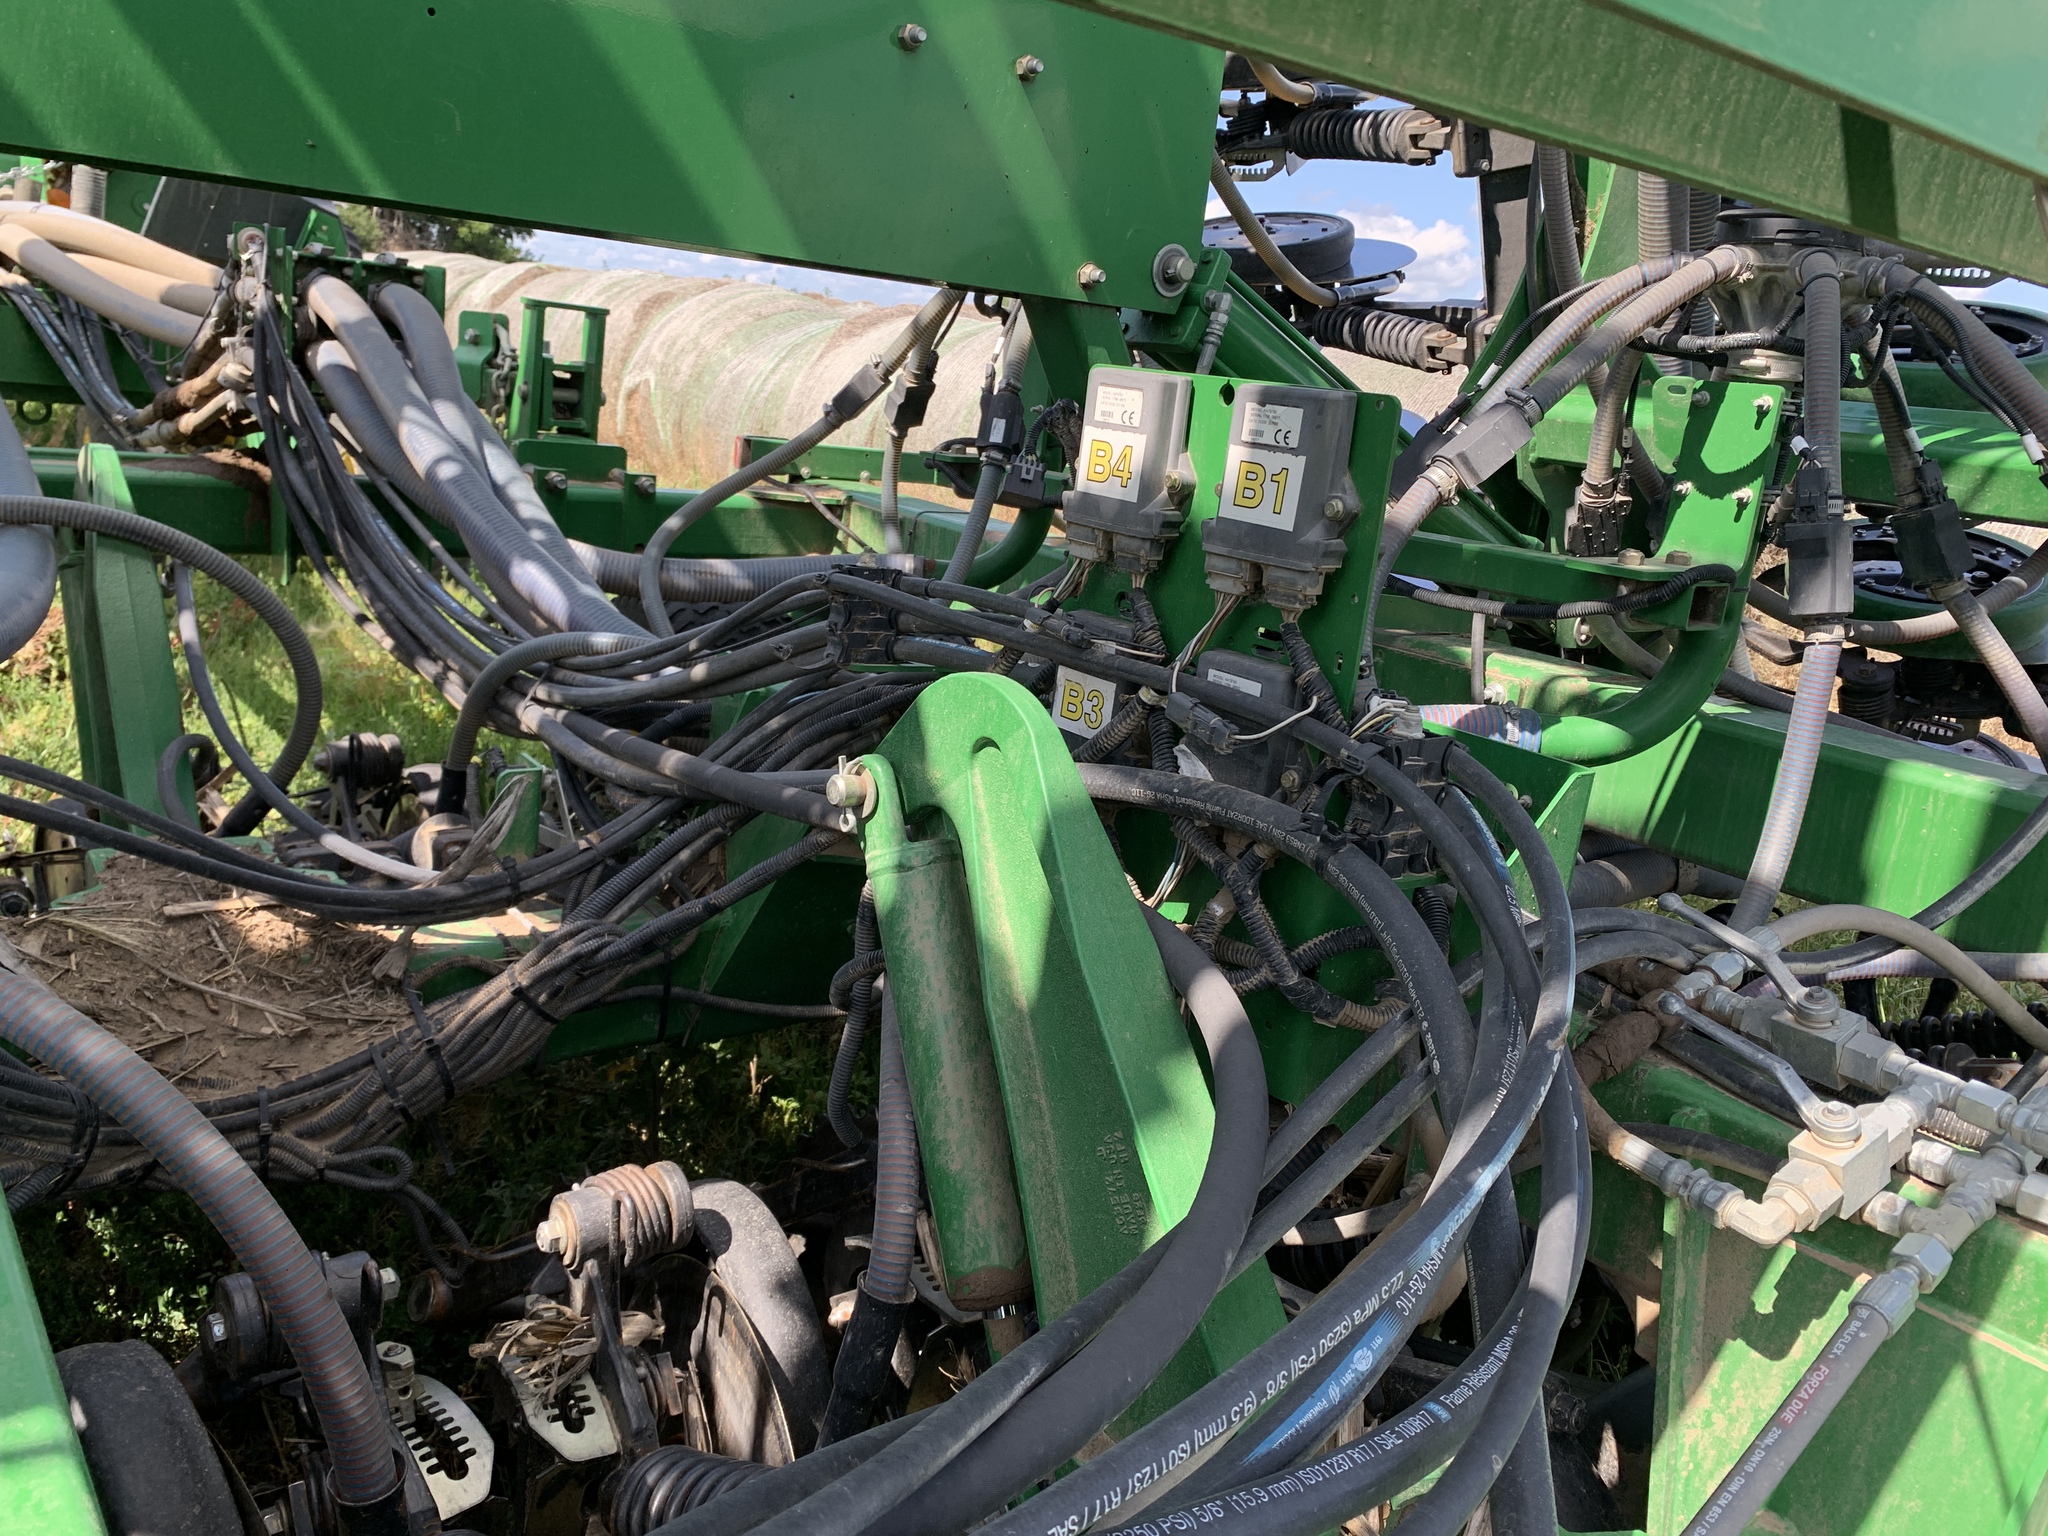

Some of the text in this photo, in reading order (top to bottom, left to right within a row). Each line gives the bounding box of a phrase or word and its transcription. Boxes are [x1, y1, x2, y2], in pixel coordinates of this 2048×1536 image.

[1274, 429, 1291, 445] CE
[1086, 439, 1133, 488] B4
[1233, 460, 1289, 514] B1
[1060, 679, 1104, 730] B3
[1205, 802, 1226, 816] Flame
[1226, 810, 1254, 826] 100R2AT
[1255, 819, 1268, 832] SAE
[1273, 827, 1286, 840] 2SN
[1285, 836, 1306, 852] EN853
[1327, 863, 1339, 878] 2SN
[1359, 895, 1372, 913] mm)
[1389, 942, 1400, 963] PSI)
[1407, 981, 1419, 1001] MPa
[1415, 999, 1425, 1019] 21.5
[1104, 1135, 1139, 1235] MADE IN USA
[1382, 1270, 1405, 1299] 22.5
[1396, 1250, 1444, 1316] MSHA 2G-11C
[1354, 1293, 1380, 1325] MPa
[1319, 1315, 1352, 1357] (3250
[1370, 1335, 1383, 1350] 1911
[1831, 1320, 1862, 1356] BALFLEX
[1290, 1347, 1317, 1381] PSI)
[1260, 1370, 1288, 1405] 3/8"
[1340, 1369, 1355, 1387] 2011
[1797, 1364, 1830, 1400] FORZA
[1230, 1390, 1257, 1427] (9.5
[1780, 1399, 1804, 1424] DUE
[1156, 1512, 1197, 1535] PSI)
[1228, 1488, 1268, 1514] (15.9
[1267, 1473, 1303, 1498] mm)
[1299, 1453, 1353, 1486] ISO11237
[1347, 1444, 1375, 1463] R17
[1374, 1430, 1403, 1450] SAE
[1395, 1410, 1435, 1438] 100R17
[1427, 1403, 1448, 1418] M3K
[1439, 1384, 1473, 1409] Flame
[1462, 1355, 1503, 1390] Resistant
[1491, 1336, 1514, 1361] MSHA
[1194, 1416, 1228, 1446] mm)
[1764, 1427, 1782, 1446] 2SN
[1125, 1441, 1191, 1500] ISO11237
[1744, 1449, 1766, 1473] DN10
[1727, 1475, 1745, 1494] DIN
[1093, 1487, 1121, 1522] R17
[1717, 1492, 1733, 1507] EN
[1081, 1506, 1089, 1530] /
[1706, 1506, 1722, 1523] 853
